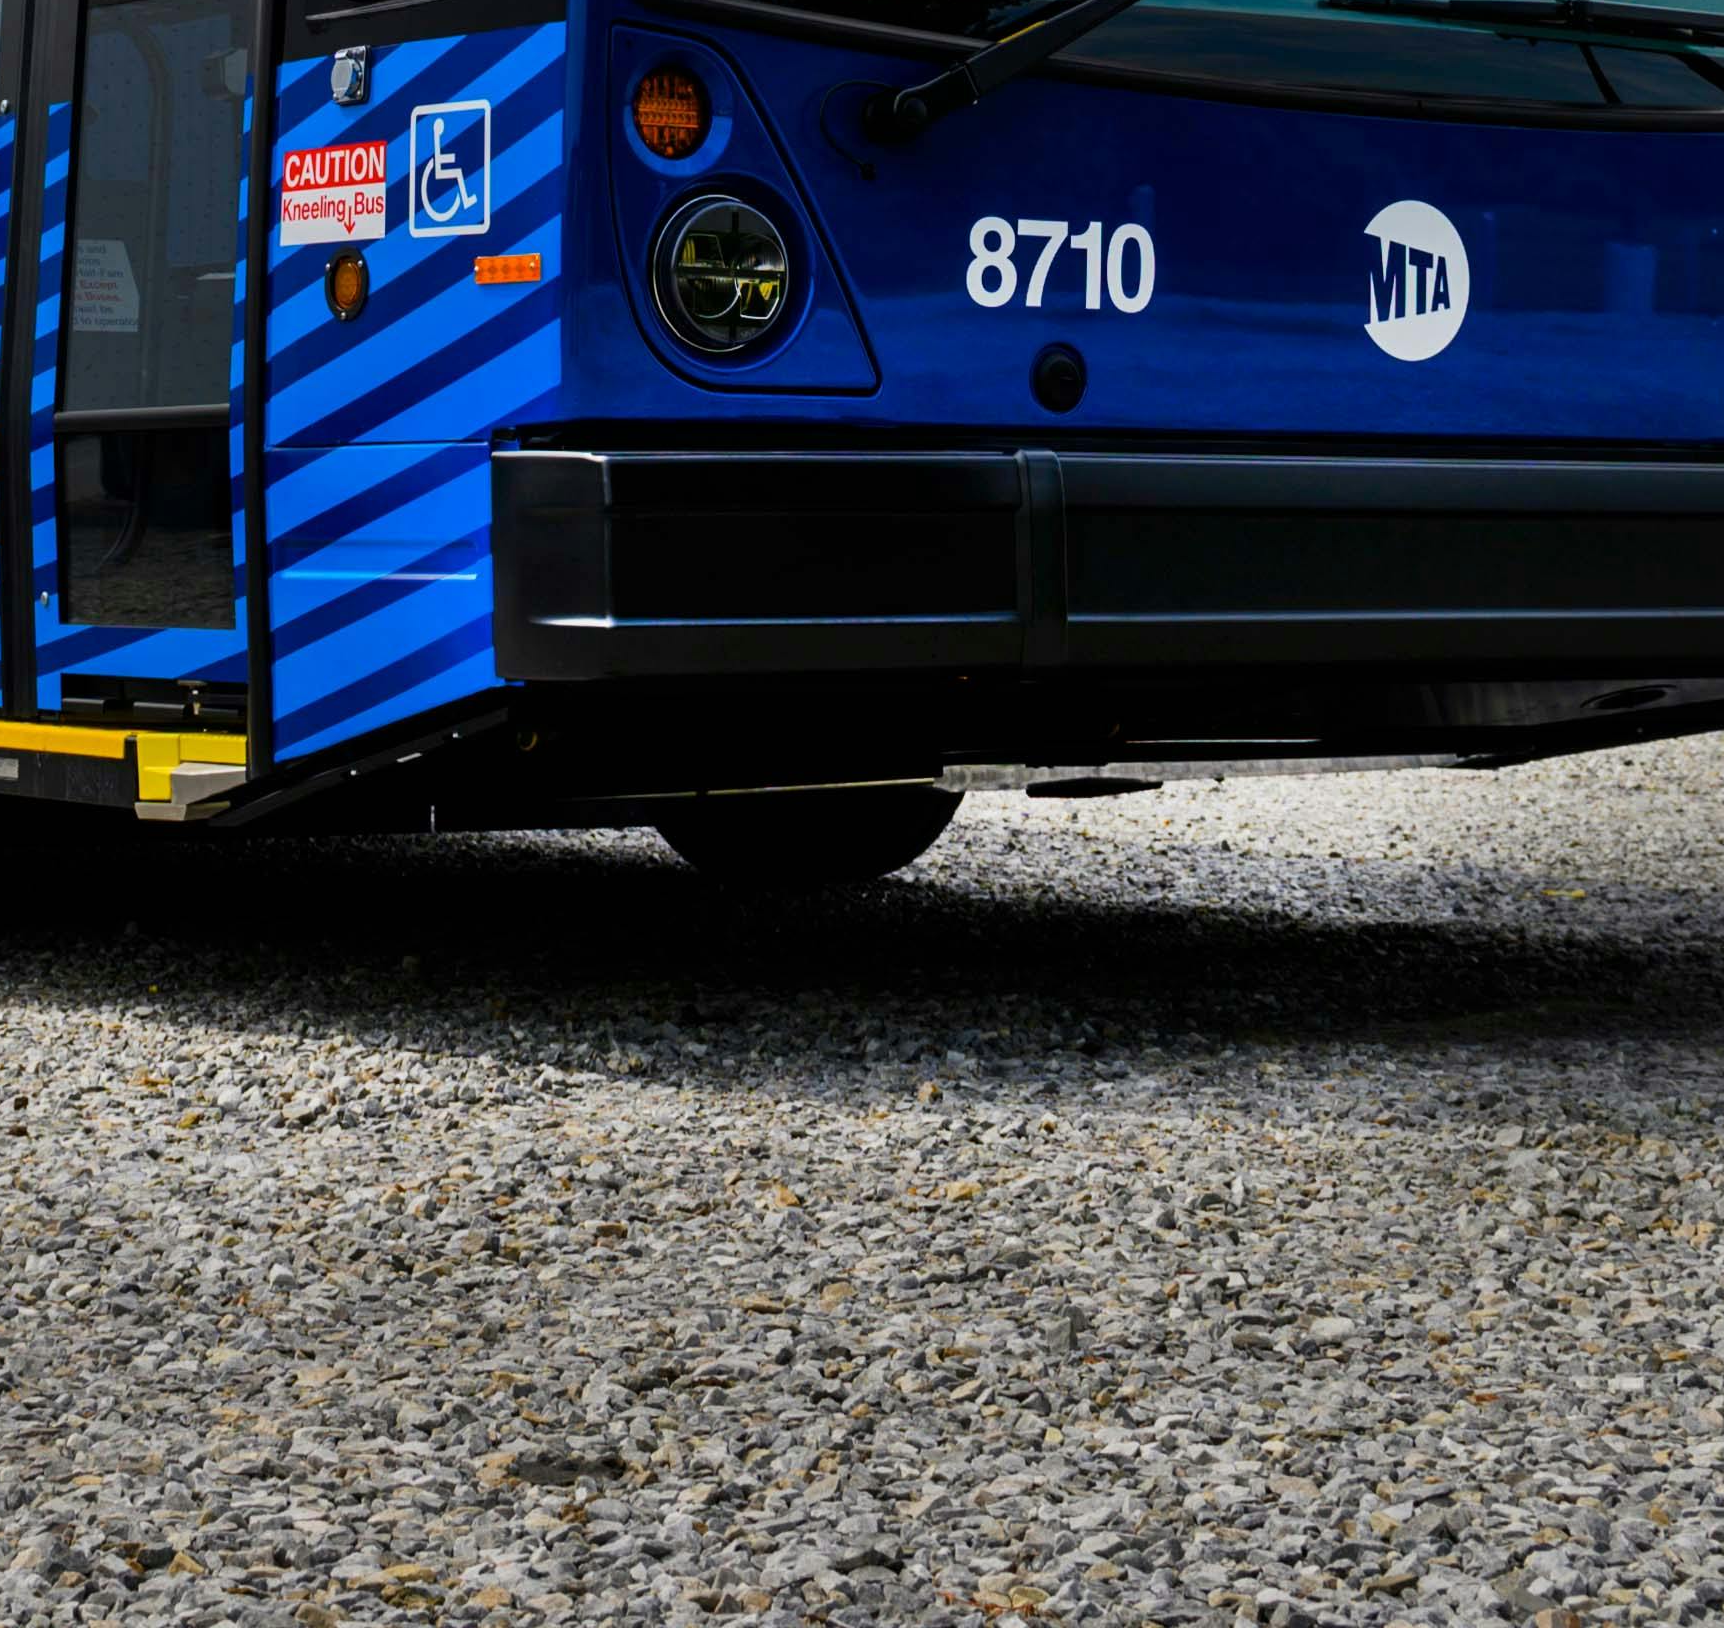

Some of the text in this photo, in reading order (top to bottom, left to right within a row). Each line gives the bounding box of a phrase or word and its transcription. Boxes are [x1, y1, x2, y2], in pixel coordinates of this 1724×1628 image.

[285, 144, 386, 189] CAUTION
[282, 191, 385, 223] Kneeling Bus
[966, 216, 1156, 314] 8710
[1366, 232, 1452, 325] MTA
